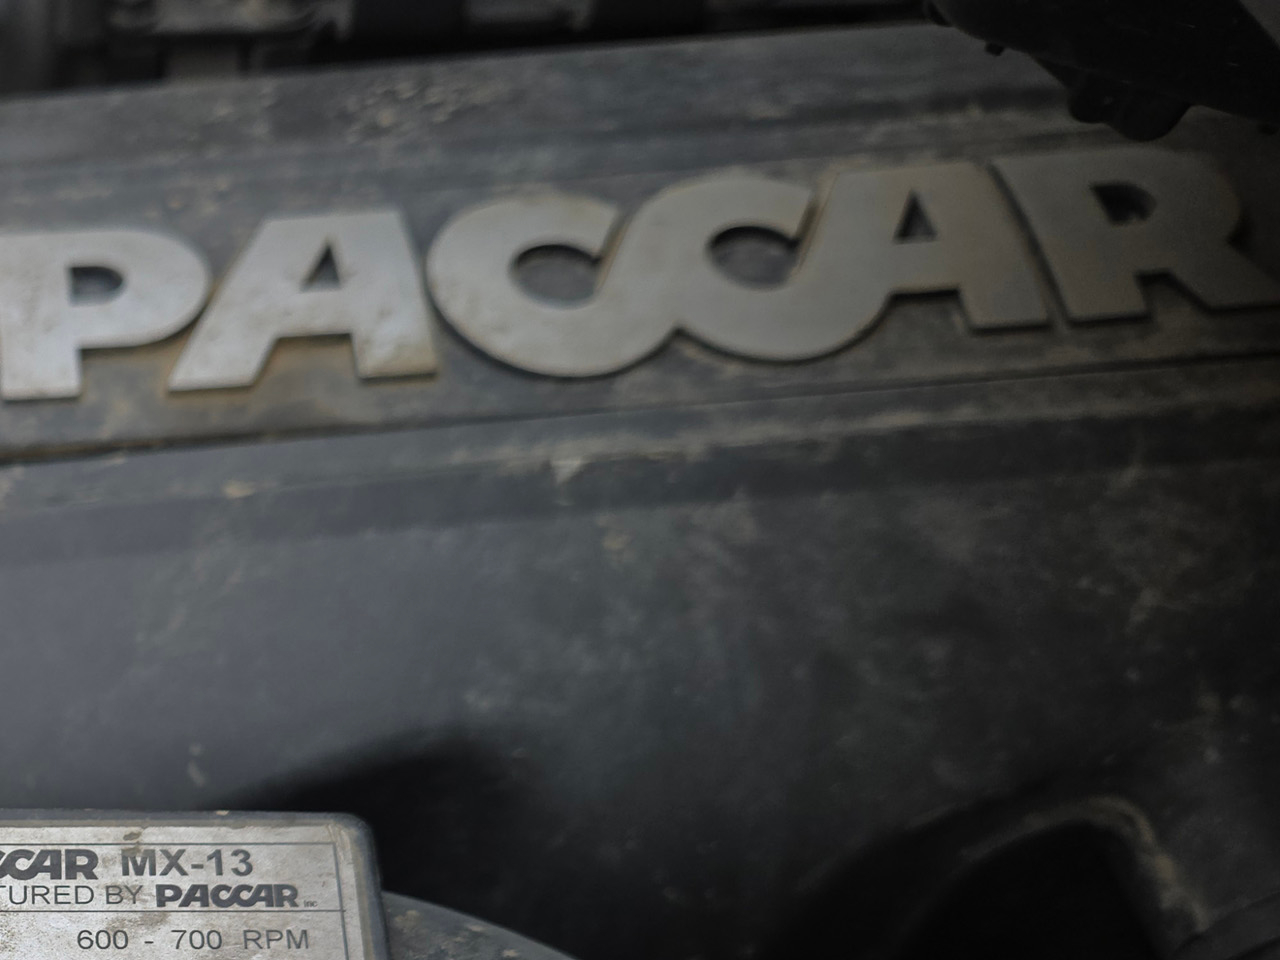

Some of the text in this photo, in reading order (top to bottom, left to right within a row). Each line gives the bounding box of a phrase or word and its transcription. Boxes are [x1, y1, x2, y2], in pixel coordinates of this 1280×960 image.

[121, 848, 254, 877] MX-13
[105, 885, 144, 905] BY
[155, 883, 300, 908] PACCAR
[76, 929, 129, 950] 600
[171, 929, 223, 950] 700
[243, 929, 310, 950] RPM
